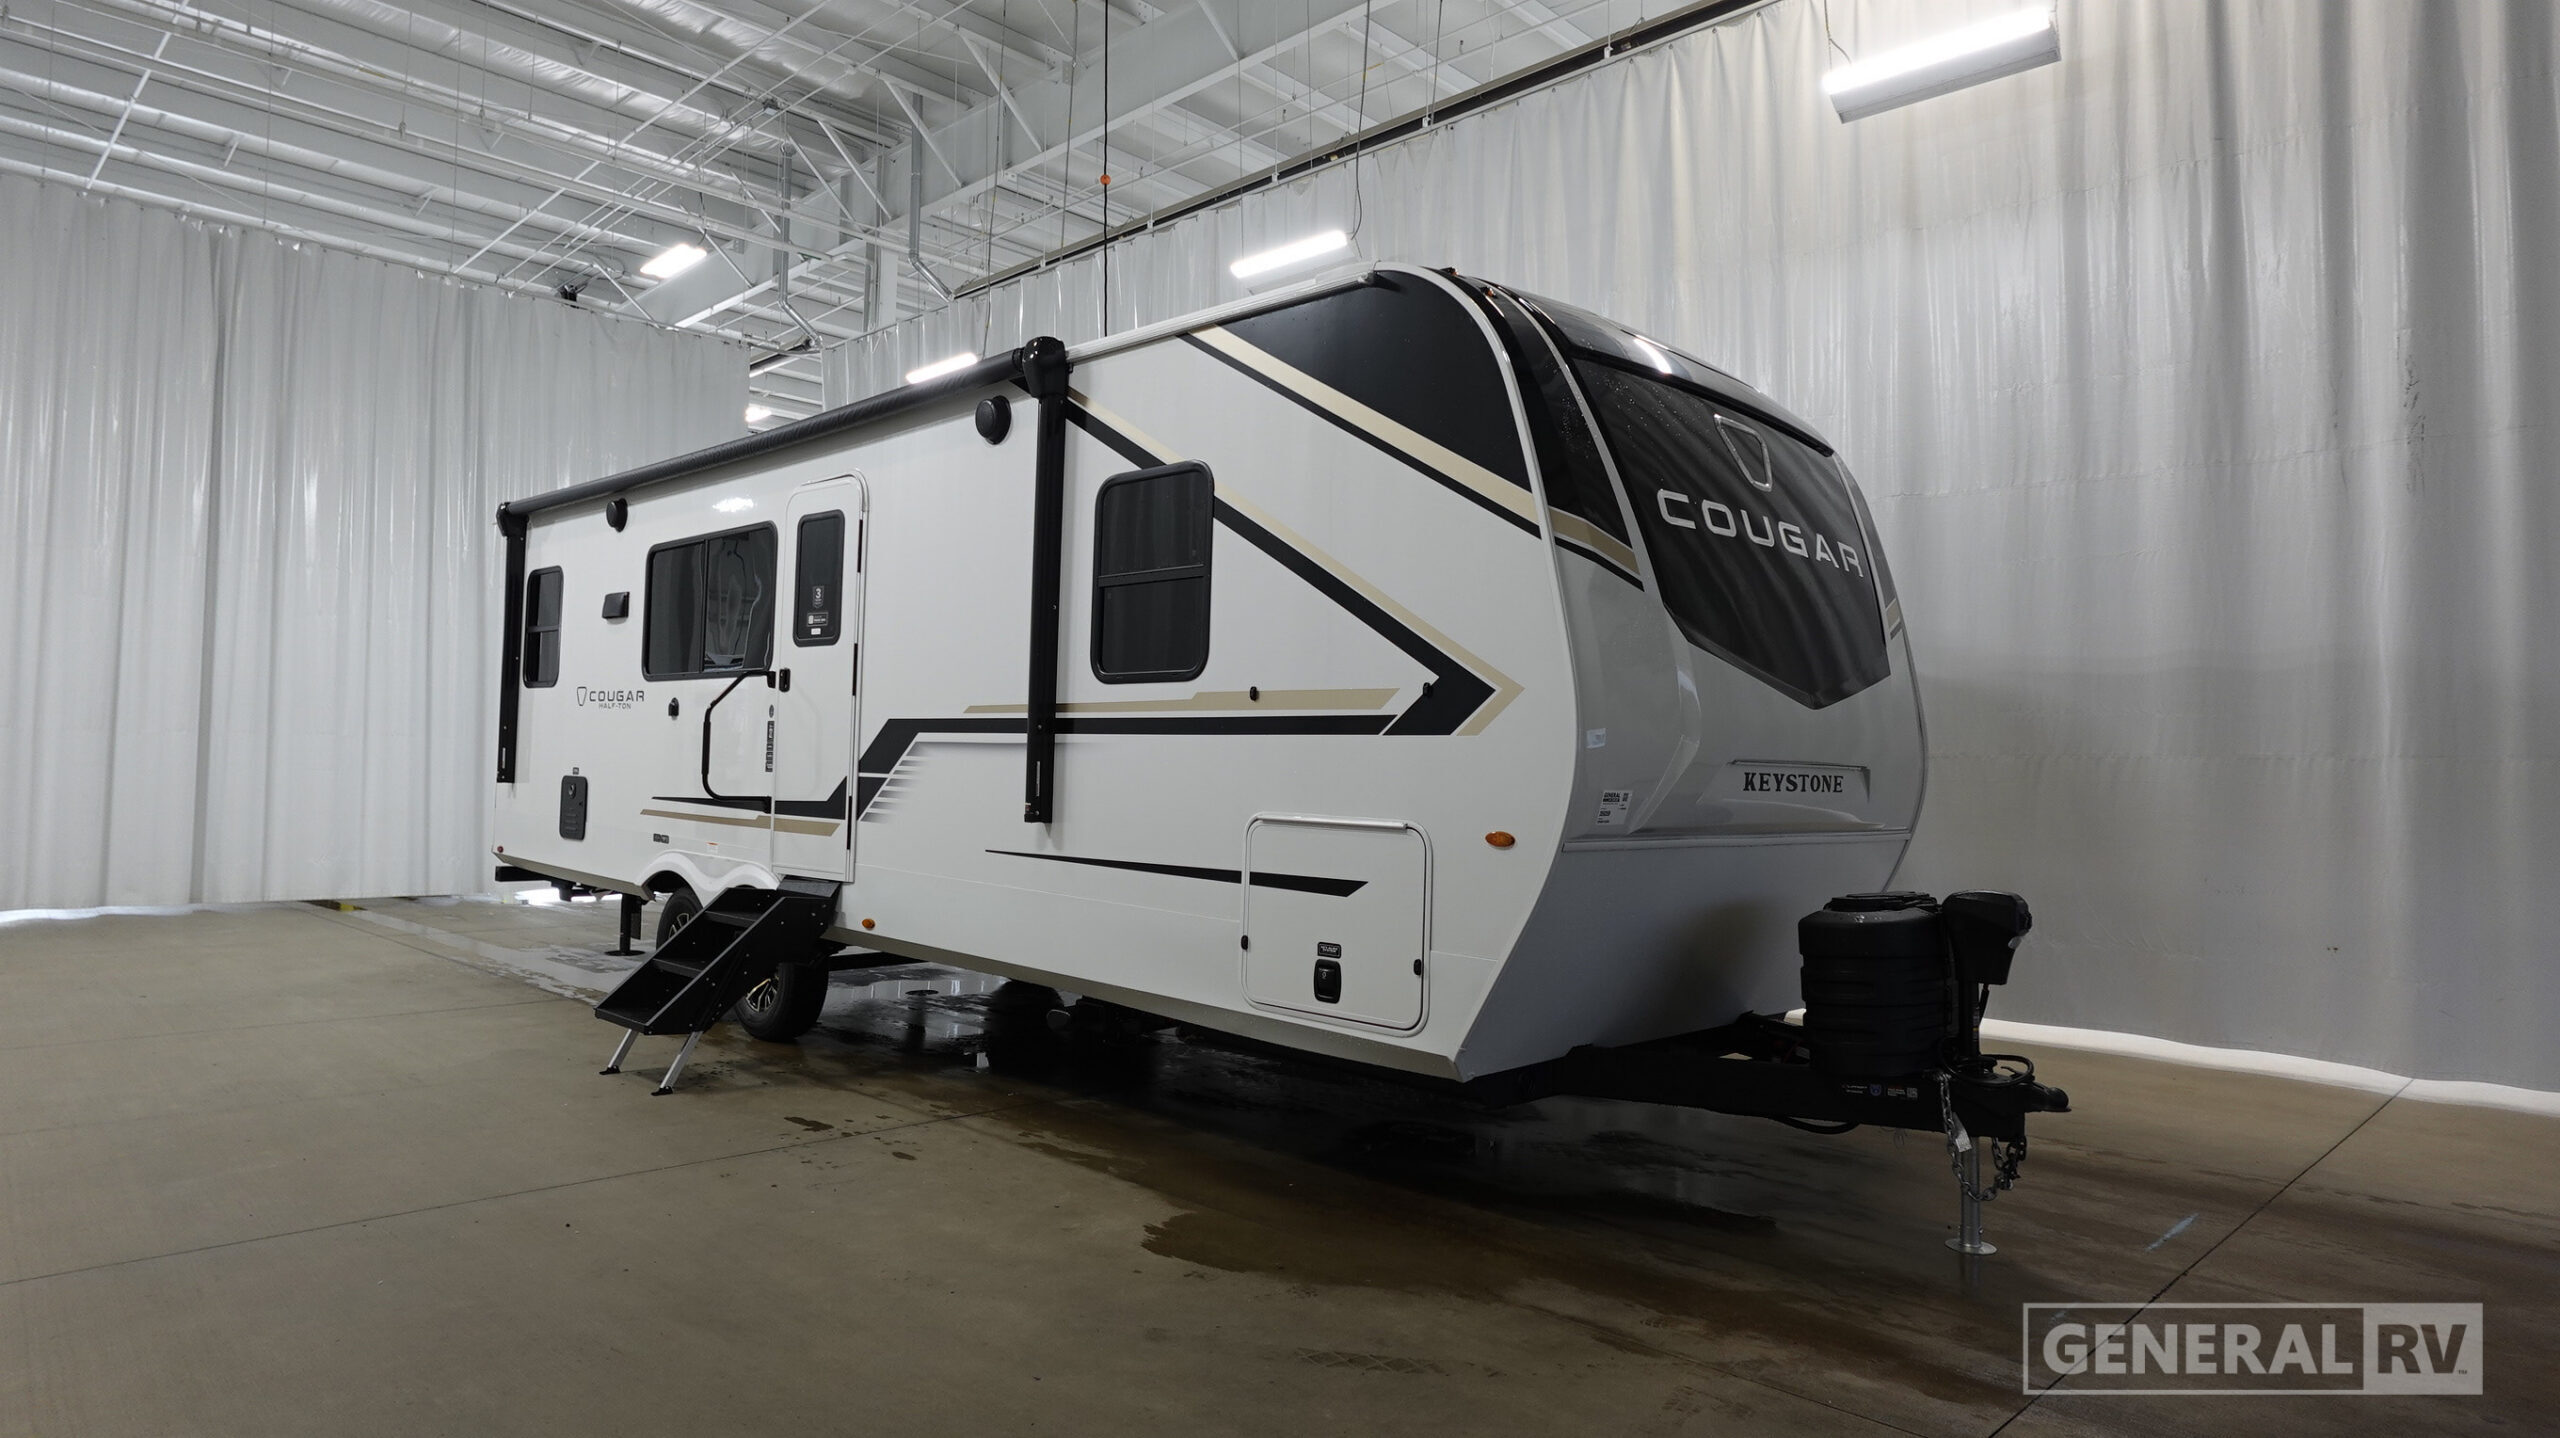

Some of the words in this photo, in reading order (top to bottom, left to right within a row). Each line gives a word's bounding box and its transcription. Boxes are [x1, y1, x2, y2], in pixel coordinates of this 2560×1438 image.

[1657, 488, 1864, 577] COUGAR
[815, 588, 821, 599] 3
[589, 690, 645, 702] COUGAR
[1743, 772, 1844, 793] KEYSTONE
